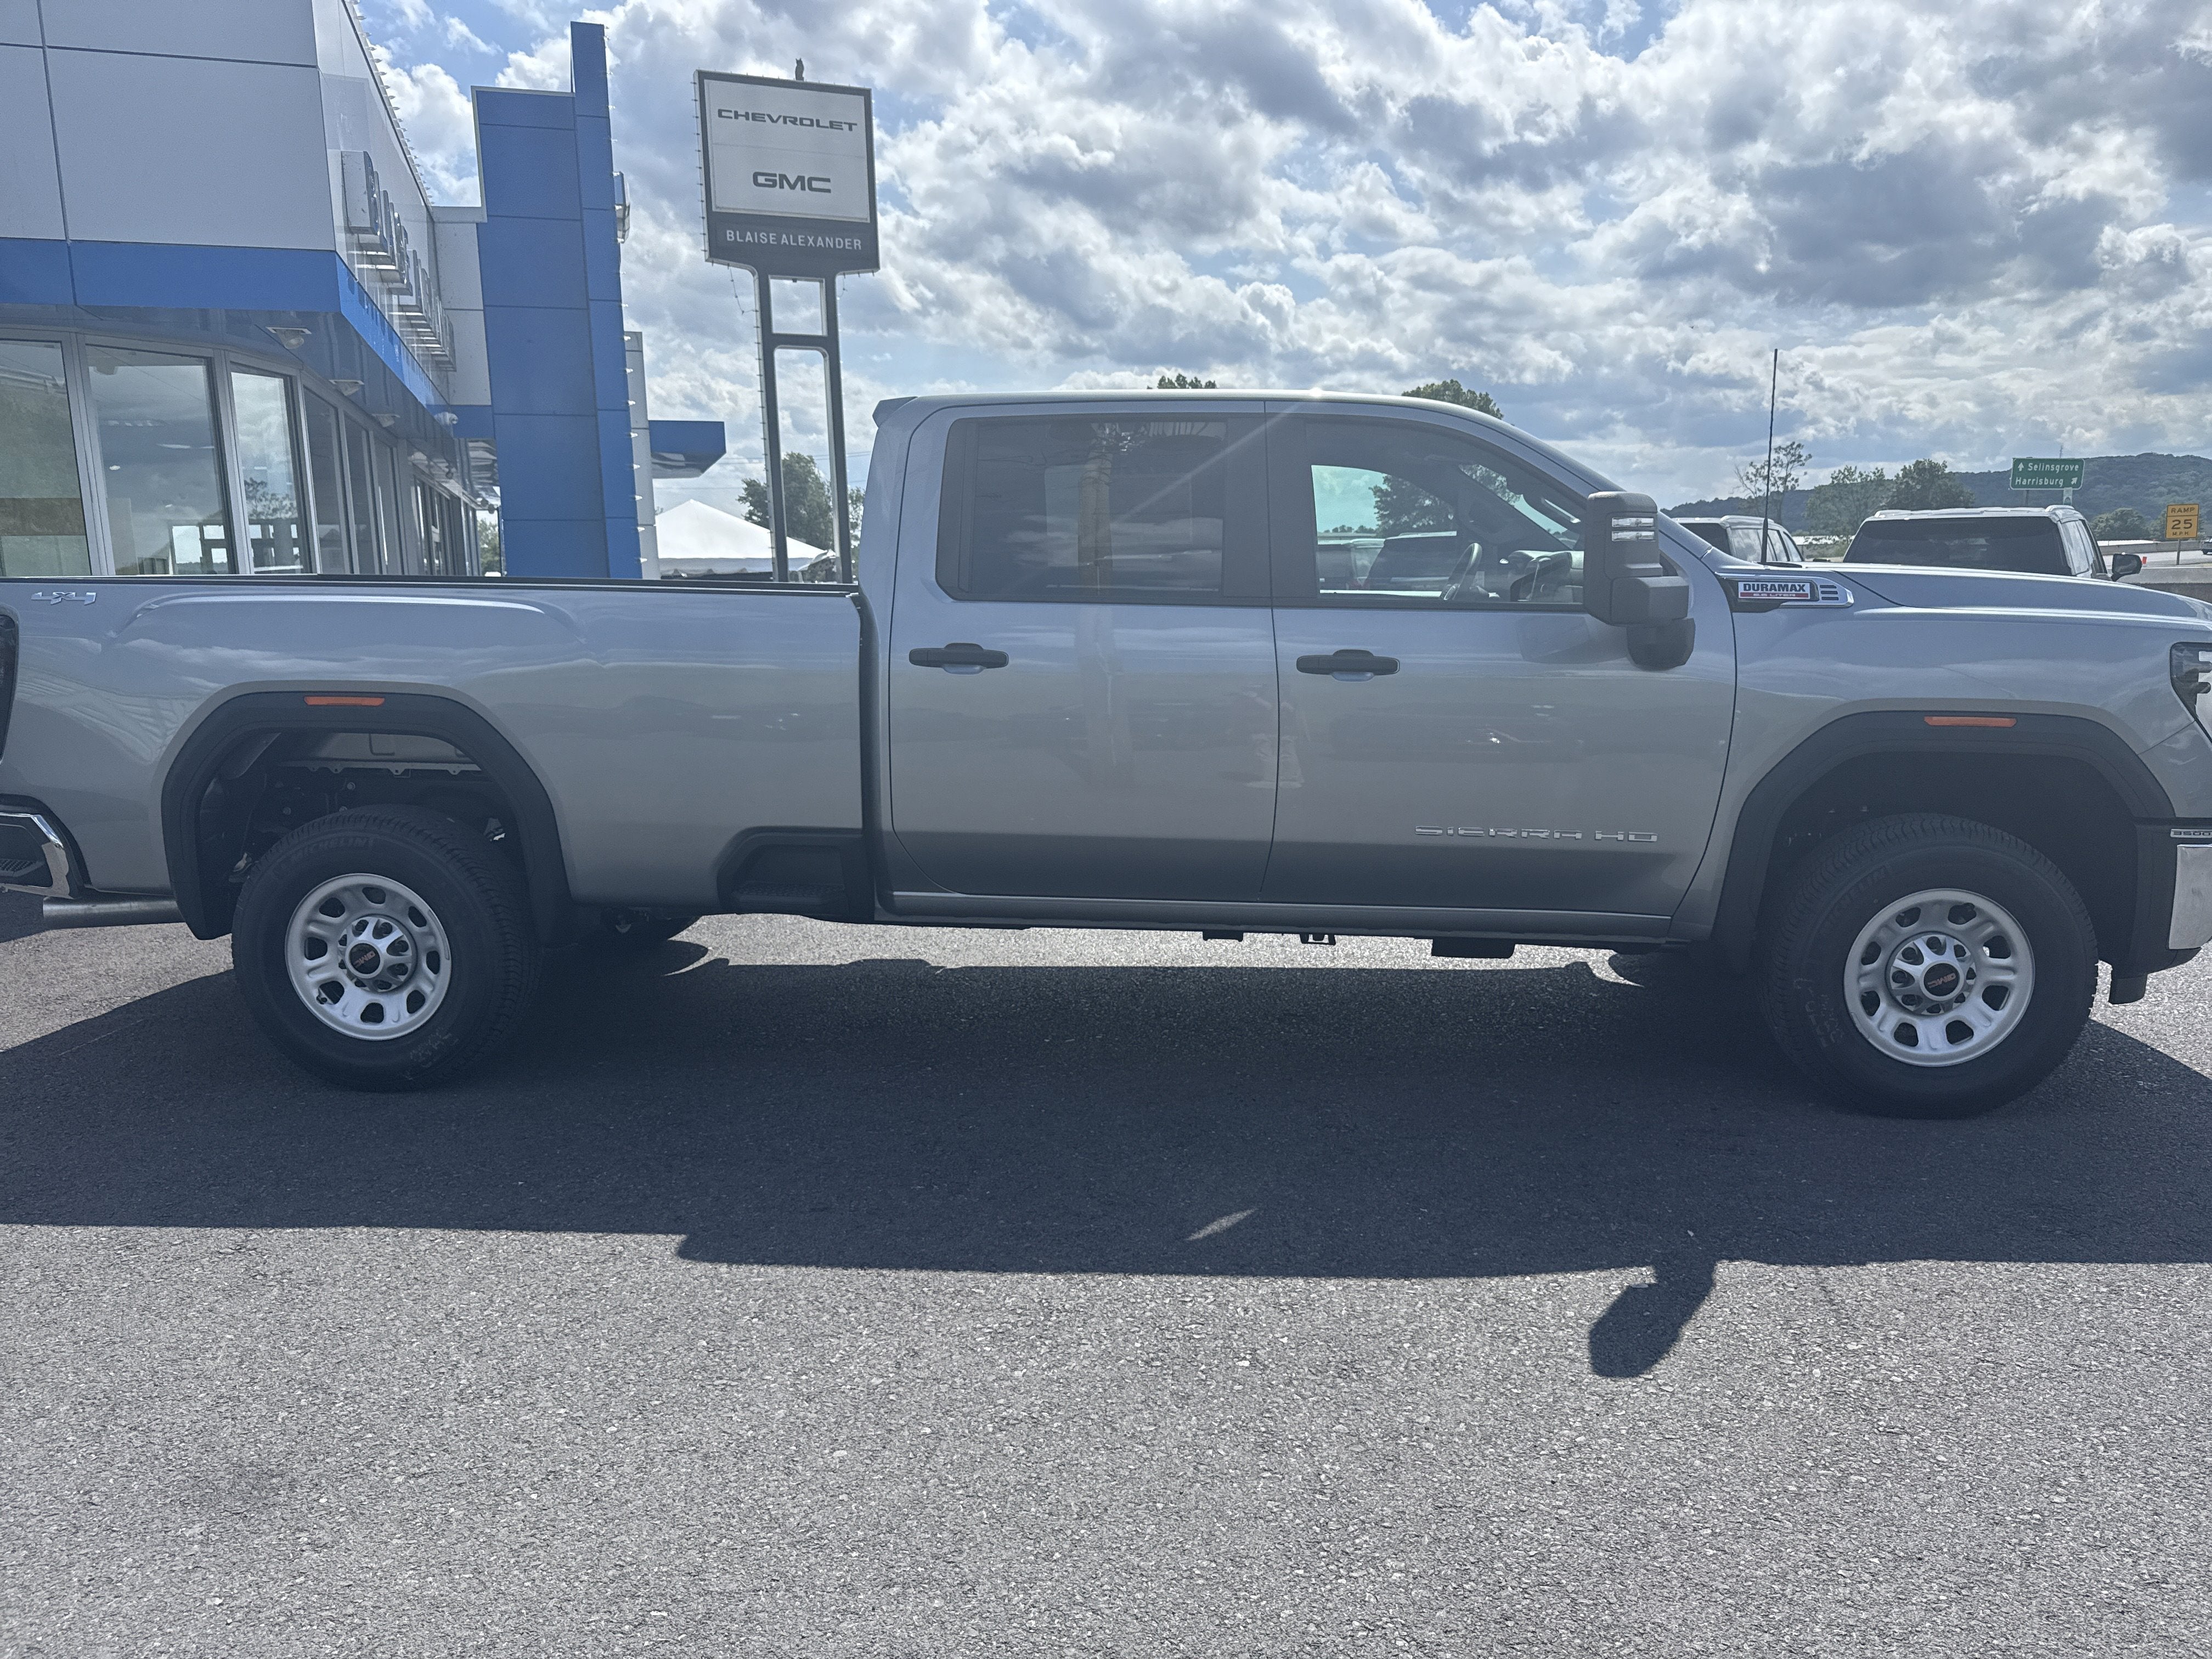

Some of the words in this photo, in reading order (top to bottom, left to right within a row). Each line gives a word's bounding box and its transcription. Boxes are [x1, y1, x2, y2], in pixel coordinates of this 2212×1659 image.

[718, 109, 857, 132] CHEVROLET
[753, 171, 831, 194] GMC
[726, 230, 777, 245] BLAISE
[781, 234, 862, 250] ALEXANDER
[2027, 462, 2079, 473] Selinsgrove
[2015, 477, 2064, 487] Harrisburg
[2171, 519, 2193, 529] 25
[1743, 583, 1806, 592] DURAMAX
[1414, 826, 1583, 839] SIERRA
[1594, 830, 1658, 842] HD
[1927, 973, 1956, 988] GMC
